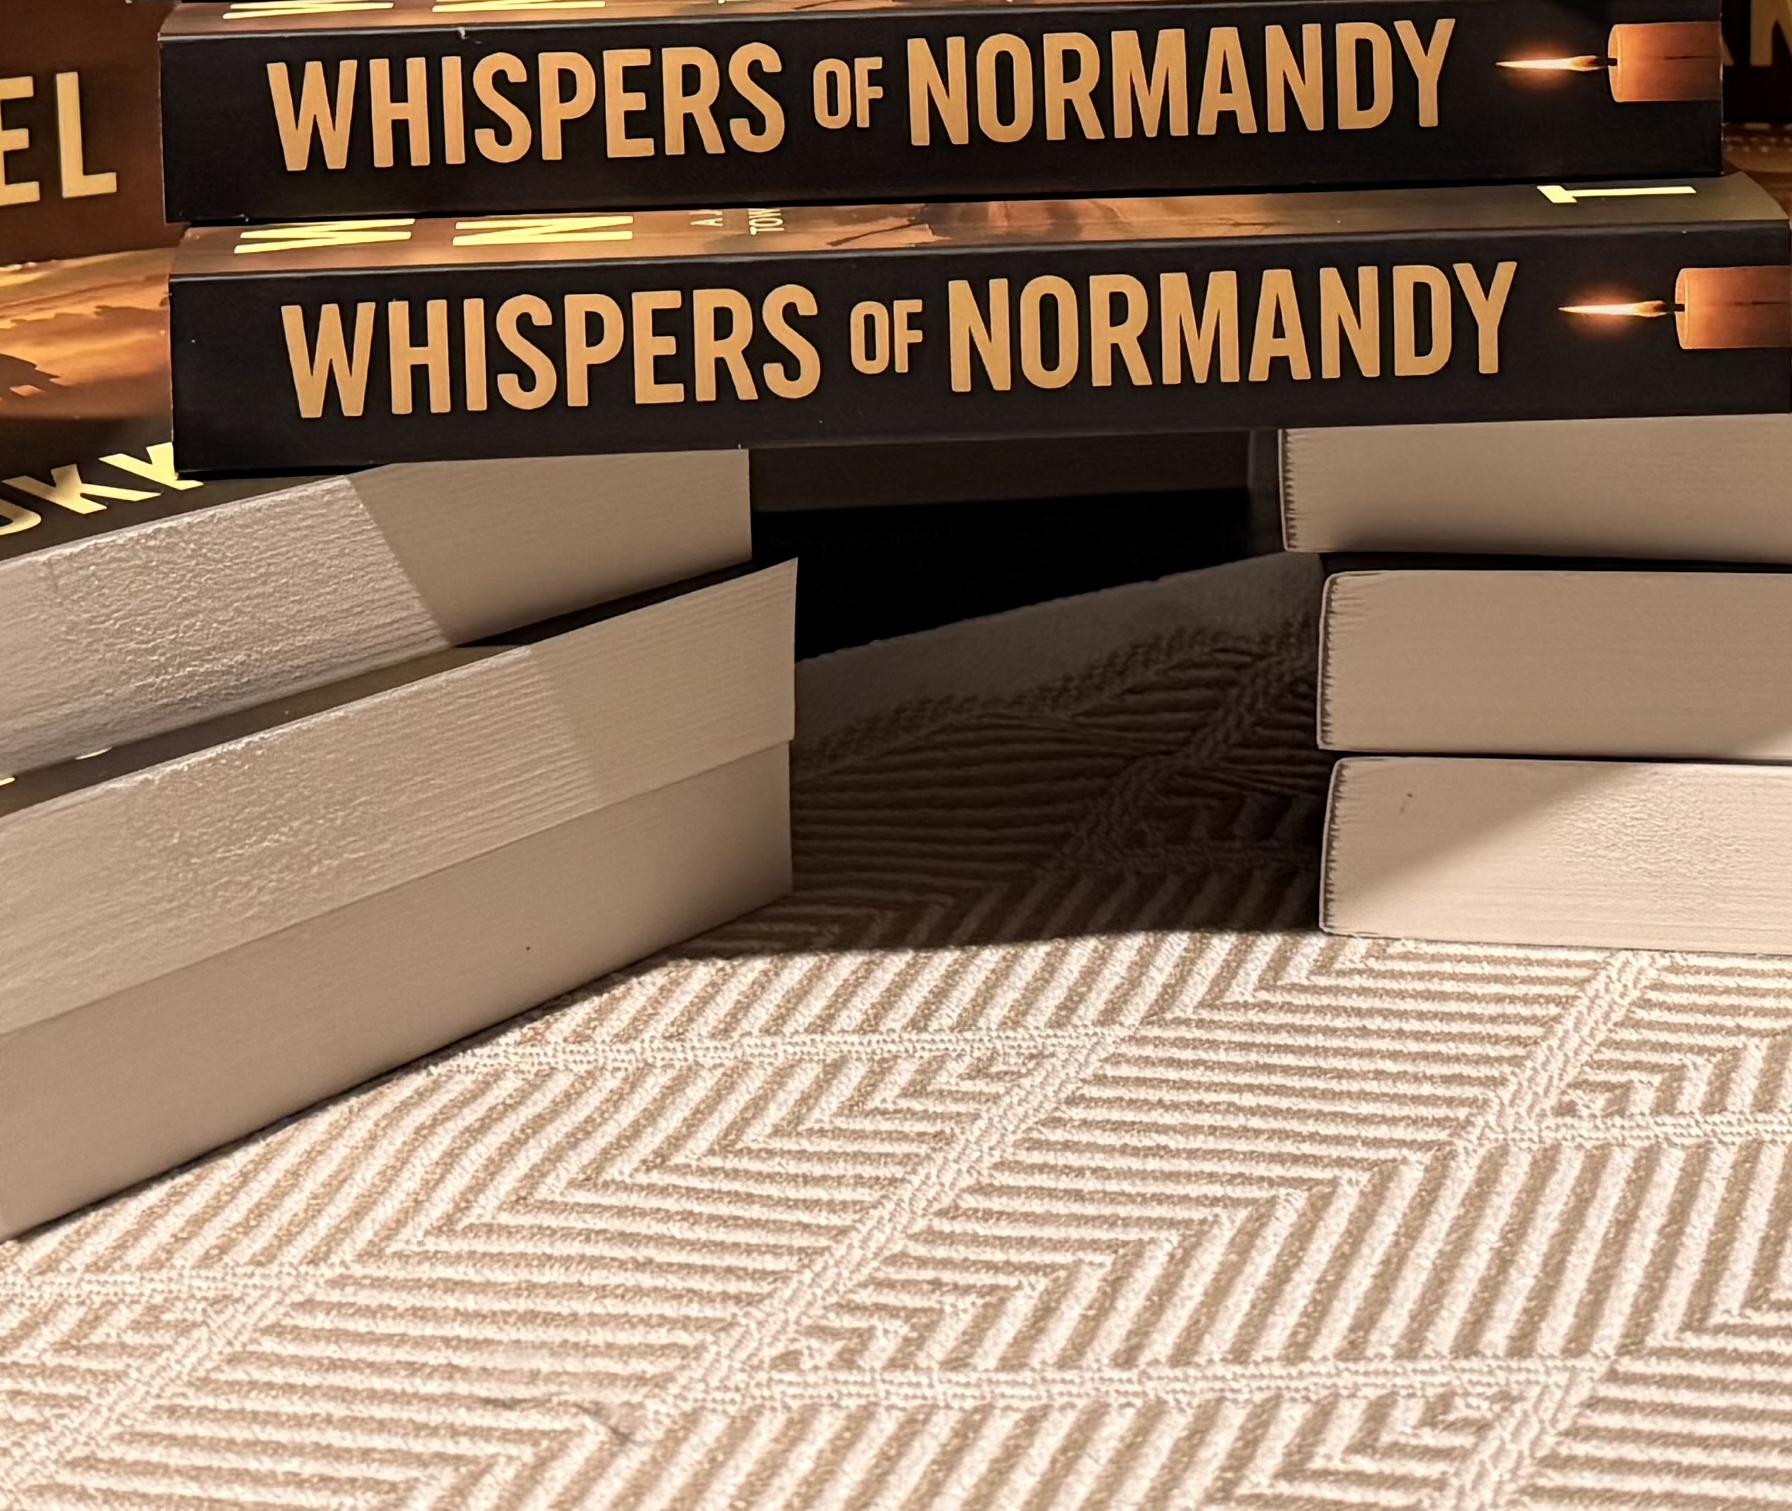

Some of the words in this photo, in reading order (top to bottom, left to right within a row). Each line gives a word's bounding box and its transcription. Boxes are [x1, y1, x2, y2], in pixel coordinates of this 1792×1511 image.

[266, 41, 786, 172] WHISPERS
[812, 56, 884, 130] OF
[906, 18, 1456, 147] NORMANDY
[280, 283, 821, 419] WHISPERS
[849, 299, 923, 375] OF
[947, 261, 1518, 393] NORMANDY
